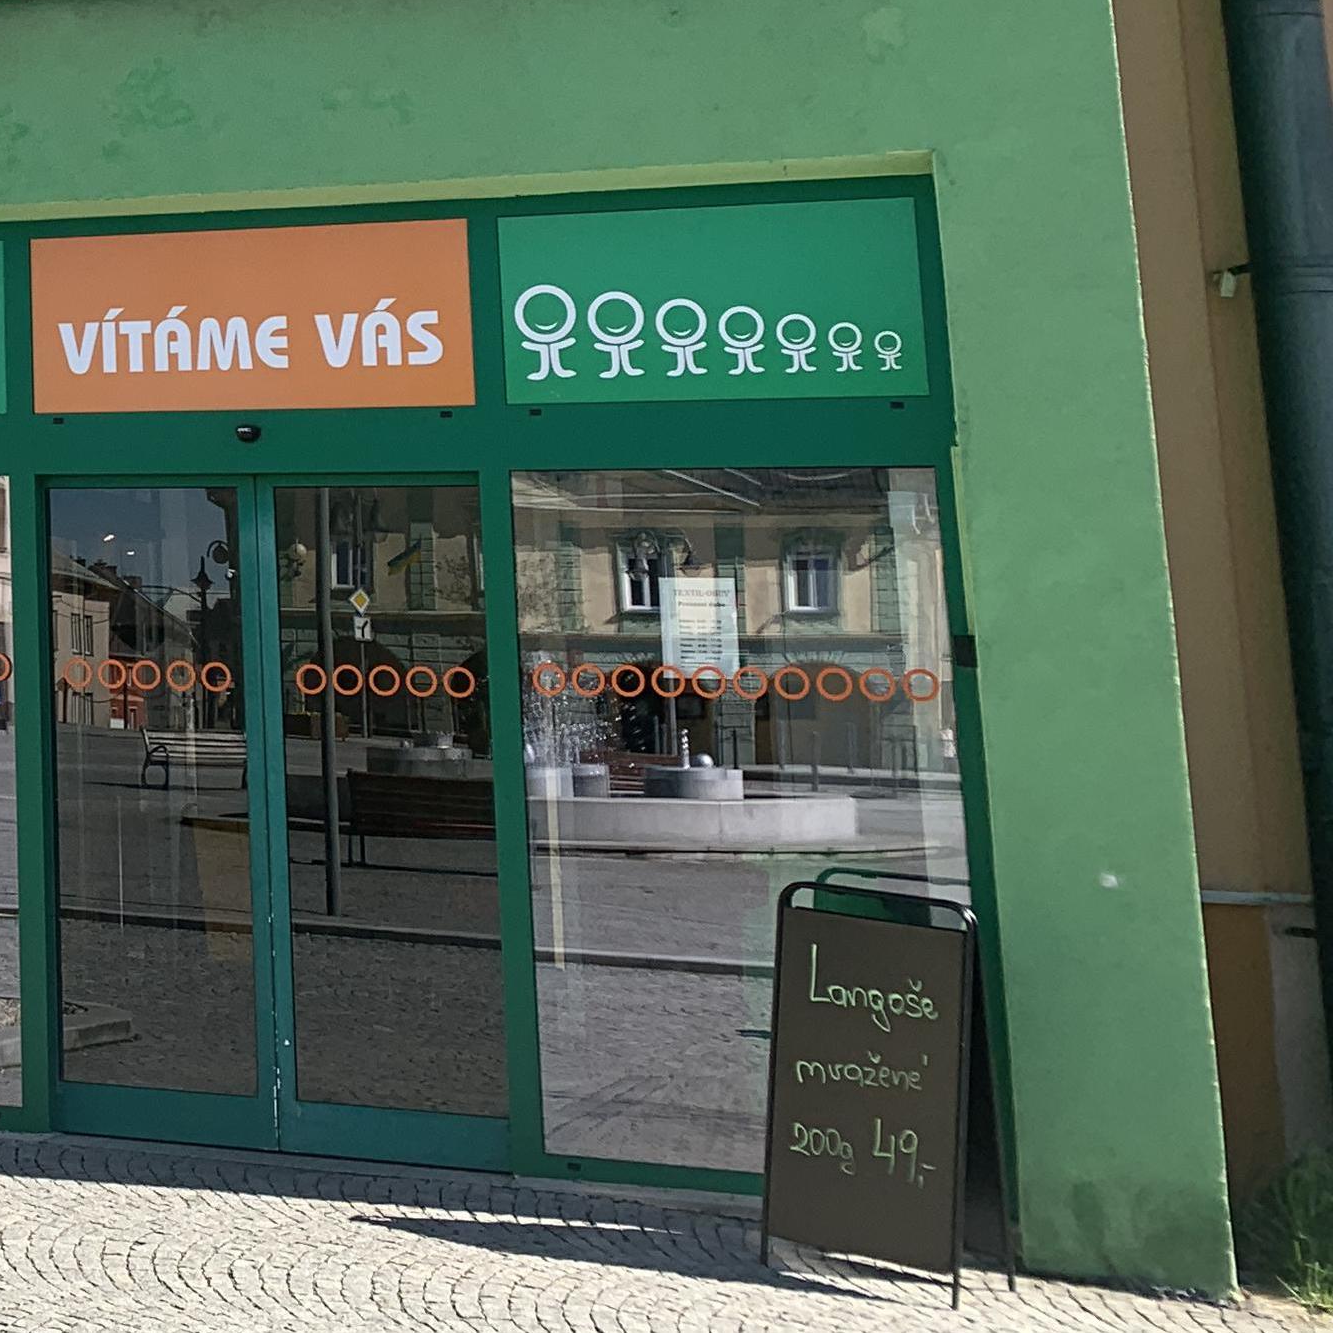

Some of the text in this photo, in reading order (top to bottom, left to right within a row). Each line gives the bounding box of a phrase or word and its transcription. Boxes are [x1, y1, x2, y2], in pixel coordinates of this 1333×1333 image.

[57, 298, 445, 375] VÍTÁME VÁS
[808, 942, 939, 1034] Langoše
[796, 1051, 929, 1091] mražené
[789, 1121, 856, 1176] 200g
